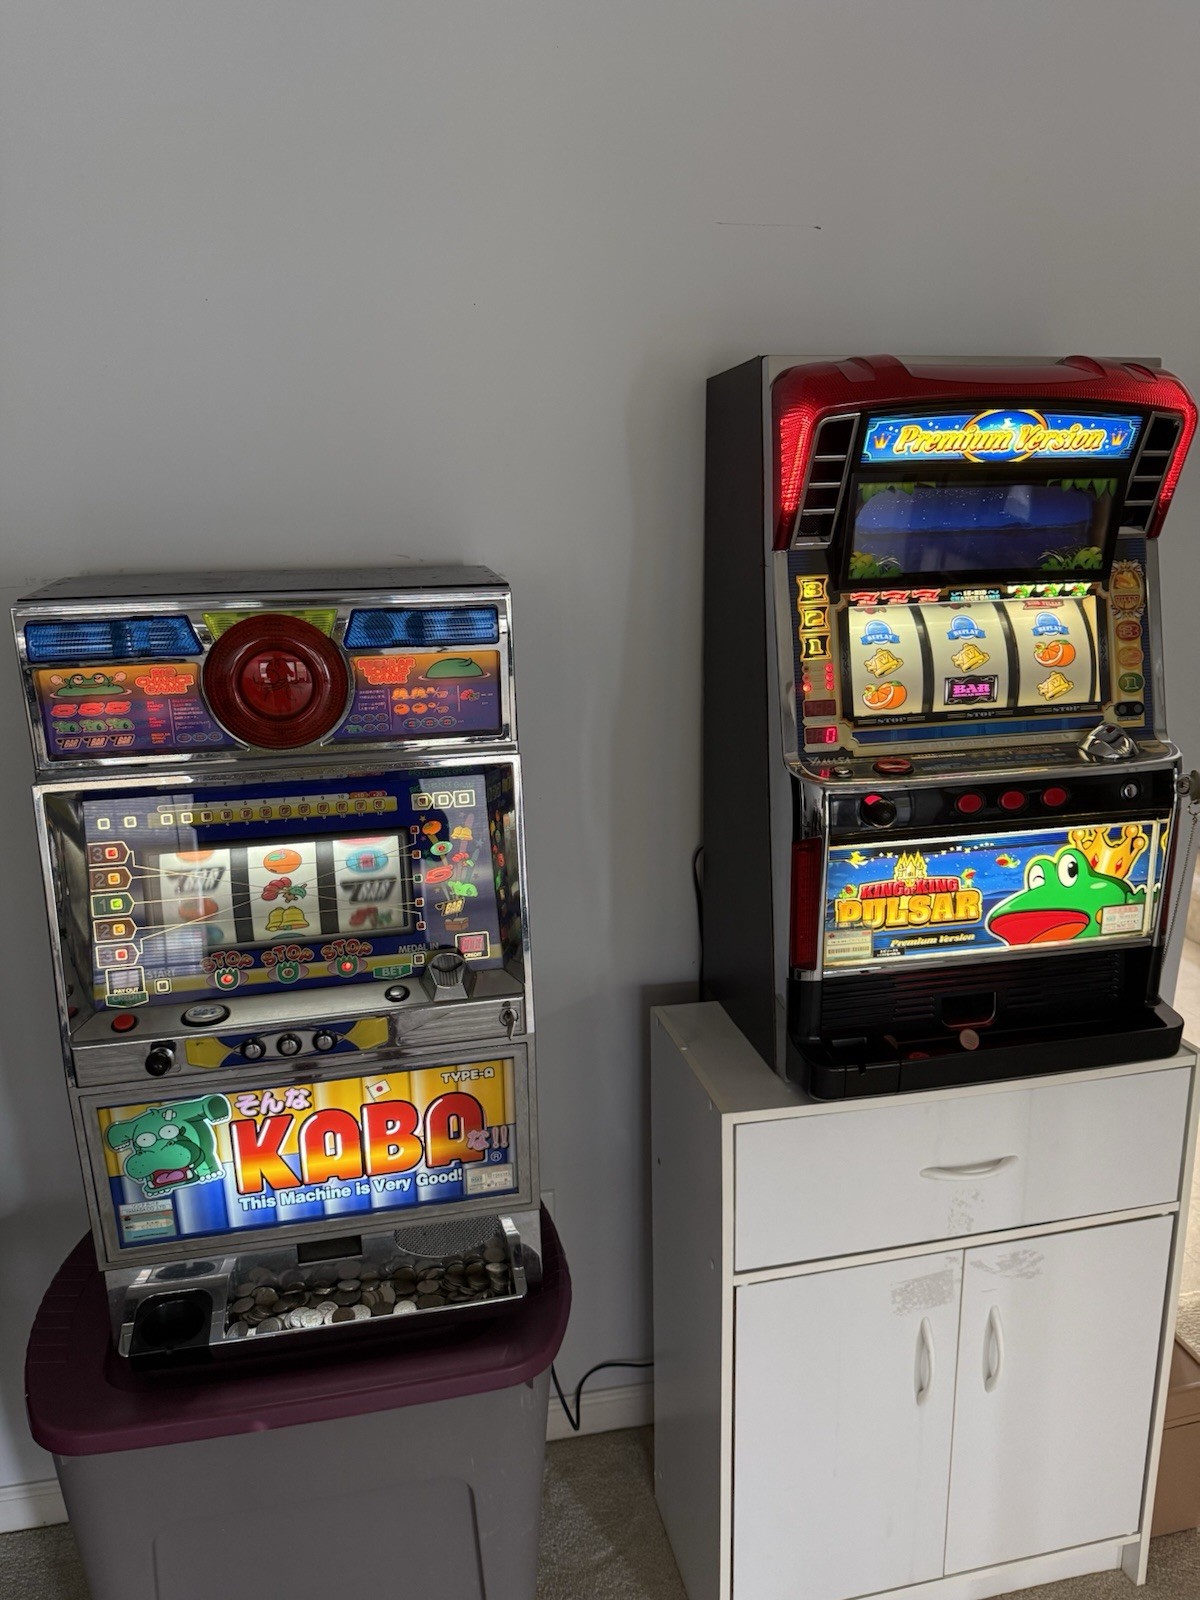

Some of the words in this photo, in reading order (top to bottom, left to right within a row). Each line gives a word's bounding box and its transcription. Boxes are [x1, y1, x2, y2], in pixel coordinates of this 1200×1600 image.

[893, 424, 1014, 453] Premium
[1014, 424, 1106, 452] Version
[953, 684, 990, 694] BAR
[860, 881, 904, 898] KING
[915, 879, 958, 894] KING
[445, 900, 462, 914] BAR
[837, 891, 981, 929] PULSAR
[321, 938, 373, 961] STOP
[398, 943, 426, 953] MEDAL
[430, 942, 439, 951] IN
[890, 938, 937, 947] Premium
[939, 934, 975, 944] Version
[201, 951, 254, 973] STOP
[261, 944, 314, 966] STOP
[146, 970, 175, 979] START
[382, 967, 403, 976] BET
[235, 1088, 312, 1117] そんな
[229, 1091, 486, 1195] KABA
[239, 1196, 276, 1212] This
[280, 1185, 351, 1206] Machine
[355, 1182, 370, 1195] is
[372, 1177, 411, 1193] Very
[416, 1168, 463, 1187] Good!
